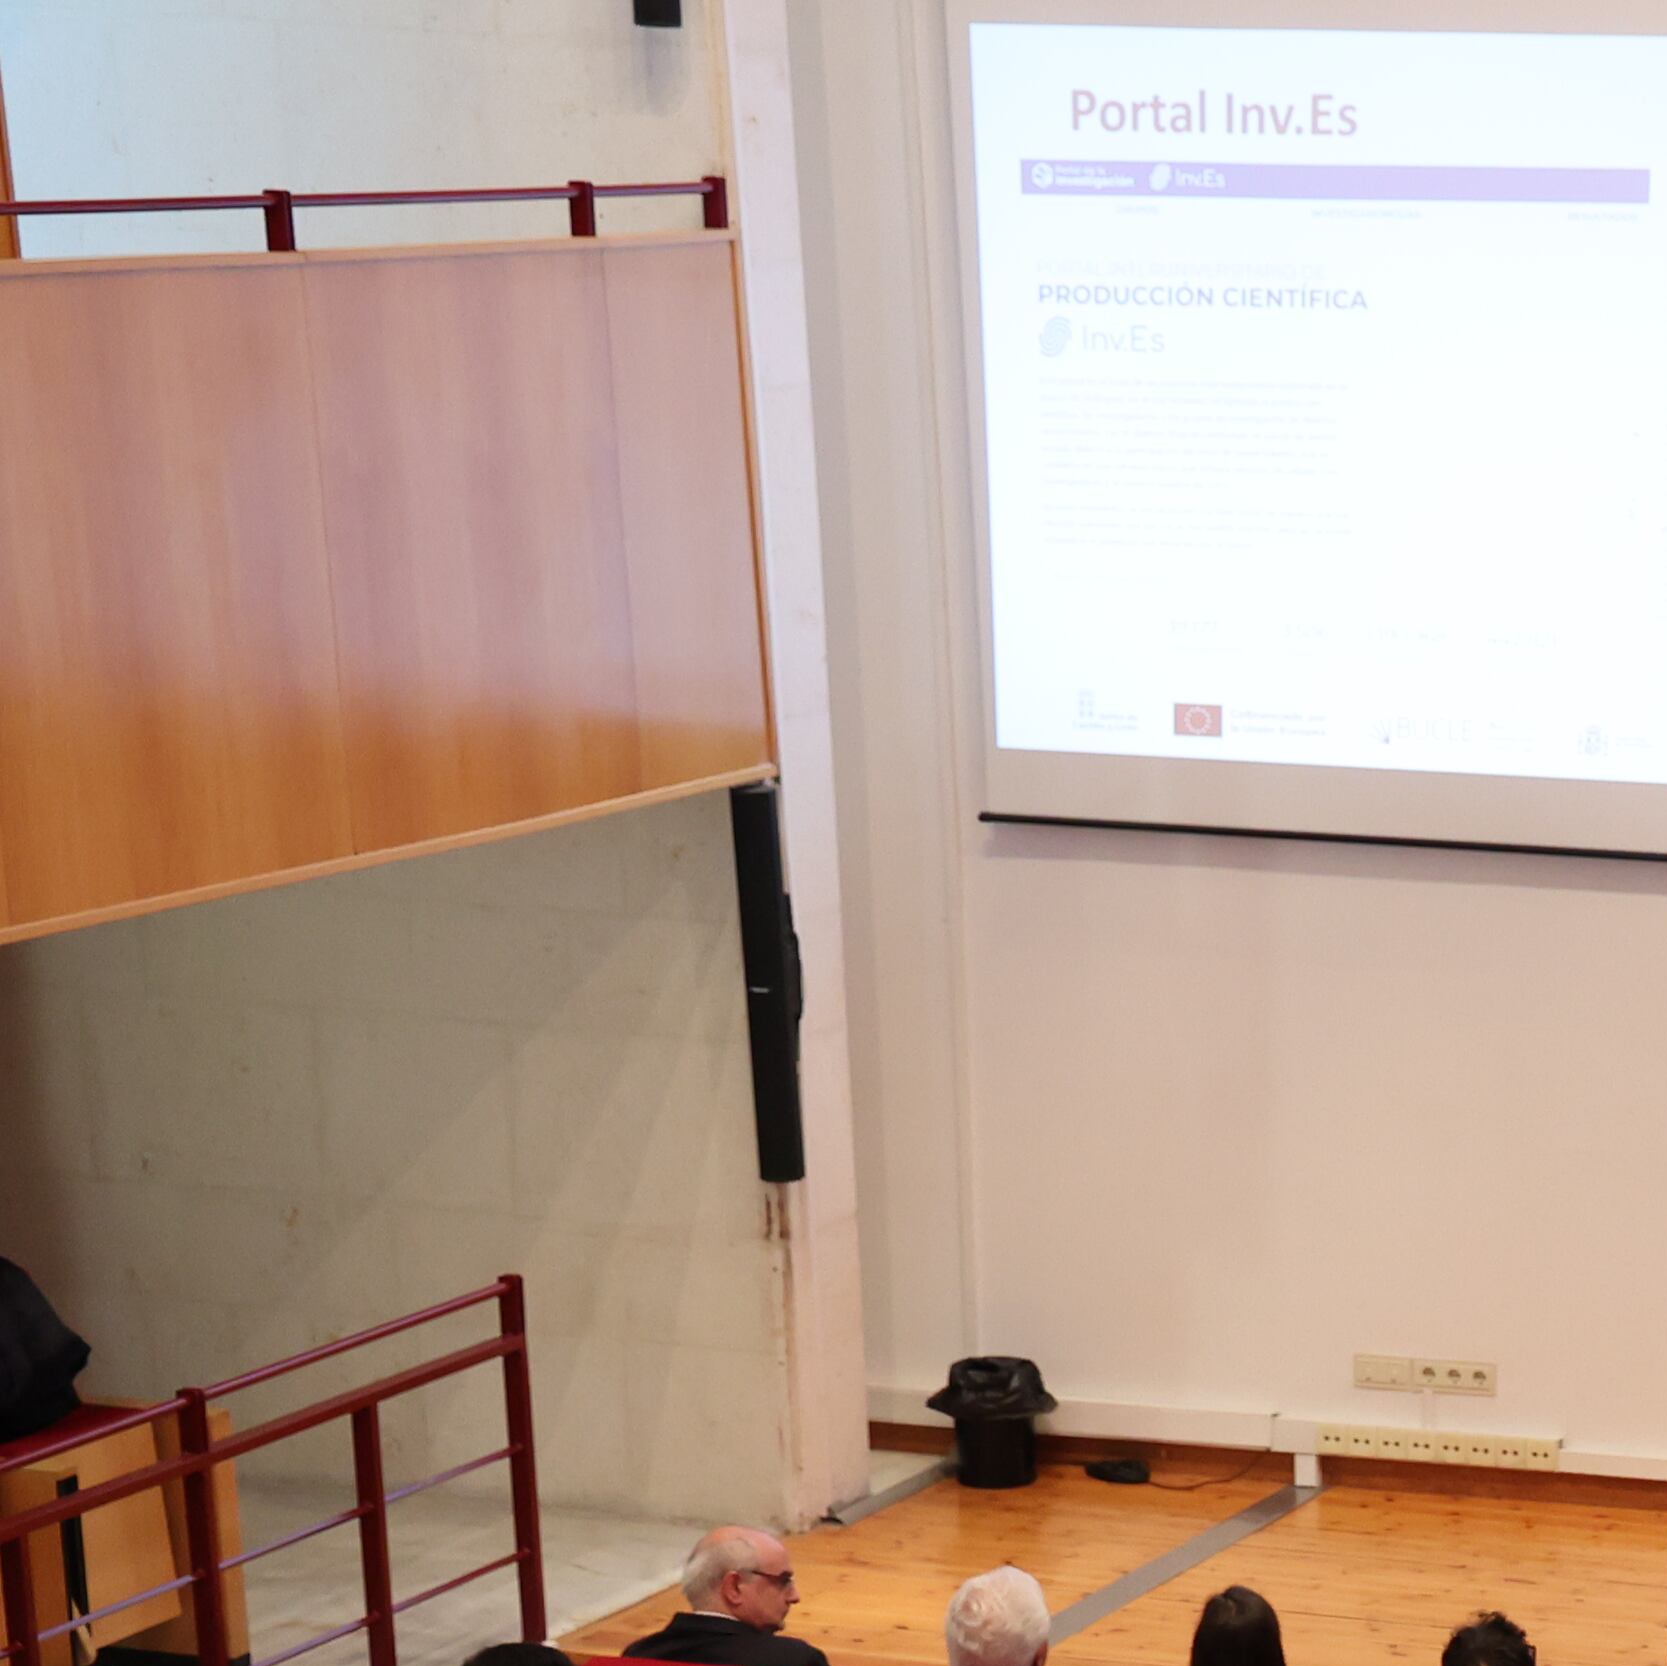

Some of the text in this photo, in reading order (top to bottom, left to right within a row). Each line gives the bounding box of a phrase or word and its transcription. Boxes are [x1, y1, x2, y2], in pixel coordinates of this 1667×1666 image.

[1070, 89, 1358, 137] Portal Inv.Es
[1174, 167, 1226, 188] Inv.Es
[1037, 281, 1369, 311] PRODUCCIÓN CIENTÍFICA
[1081, 324, 1166, 353] Inv.Es
